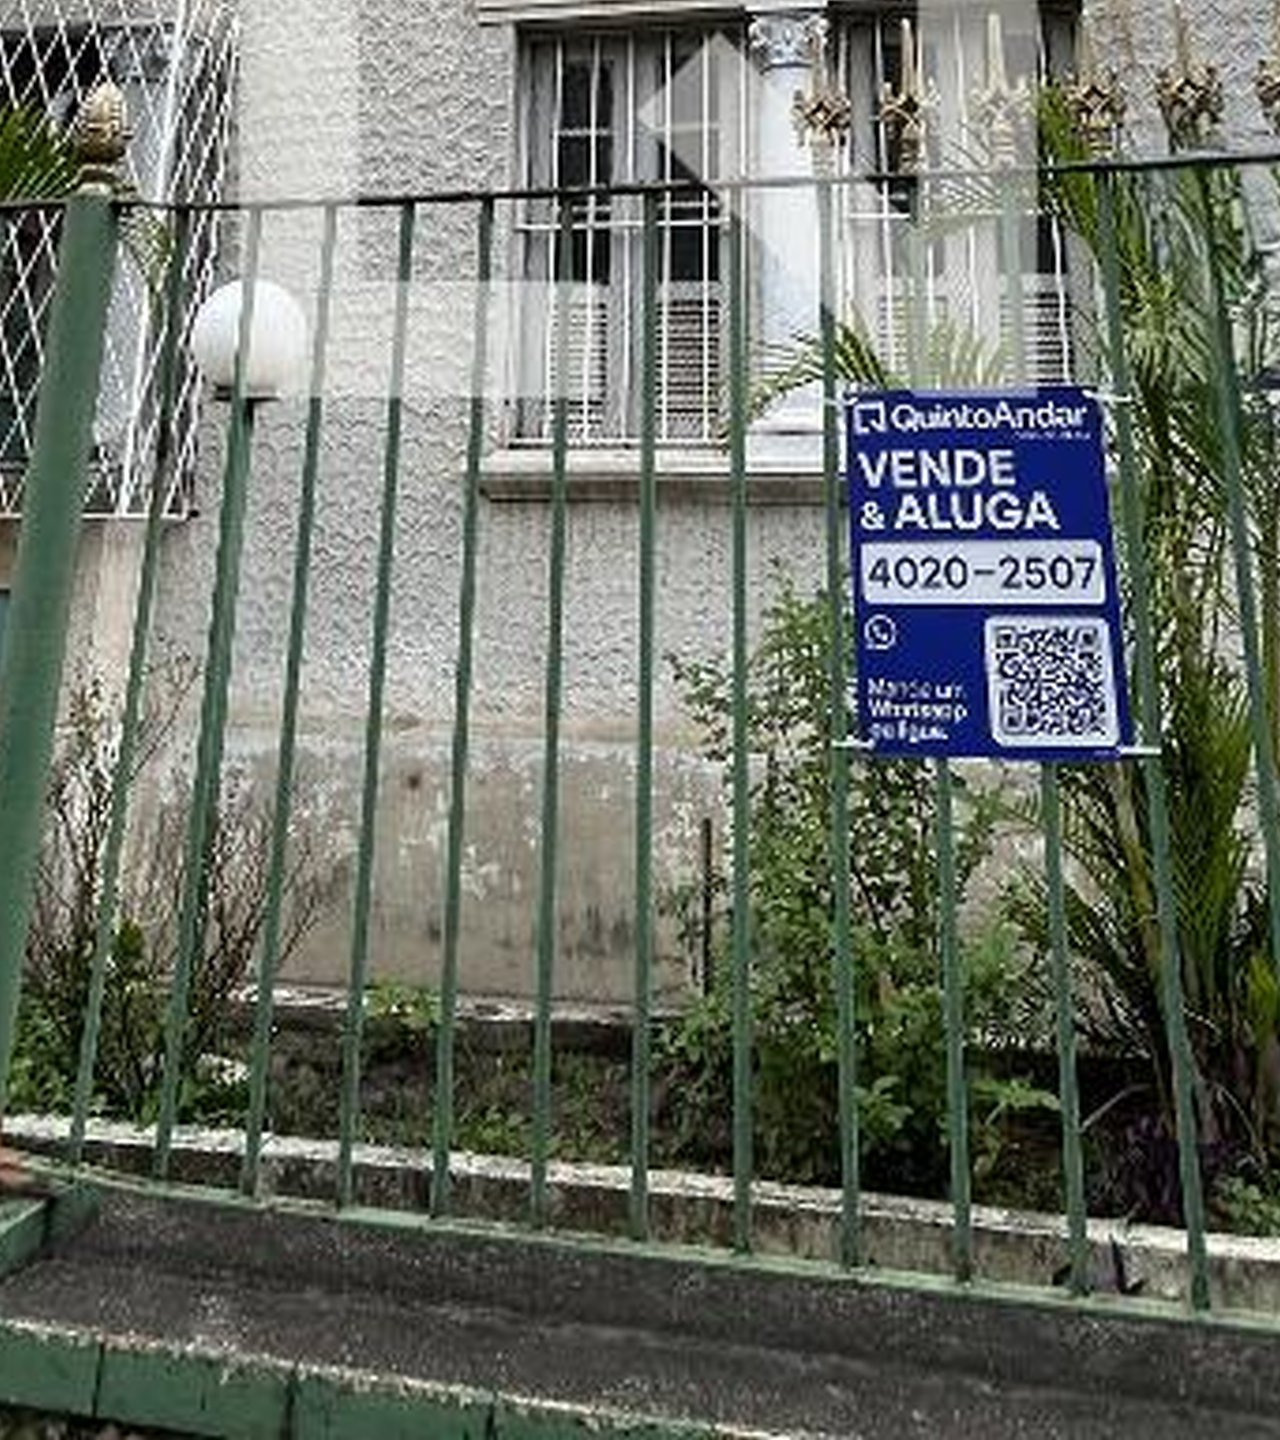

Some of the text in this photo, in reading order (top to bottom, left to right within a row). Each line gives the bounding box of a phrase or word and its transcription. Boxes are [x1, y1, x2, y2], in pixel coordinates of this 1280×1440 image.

[891, 401, 1088, 432] QuintoAndar
[857, 449, 1016, 488] VENDE
[860, 490, 1061, 530] & ALUGA
[868, 555, 1096, 589] 4020-2507
